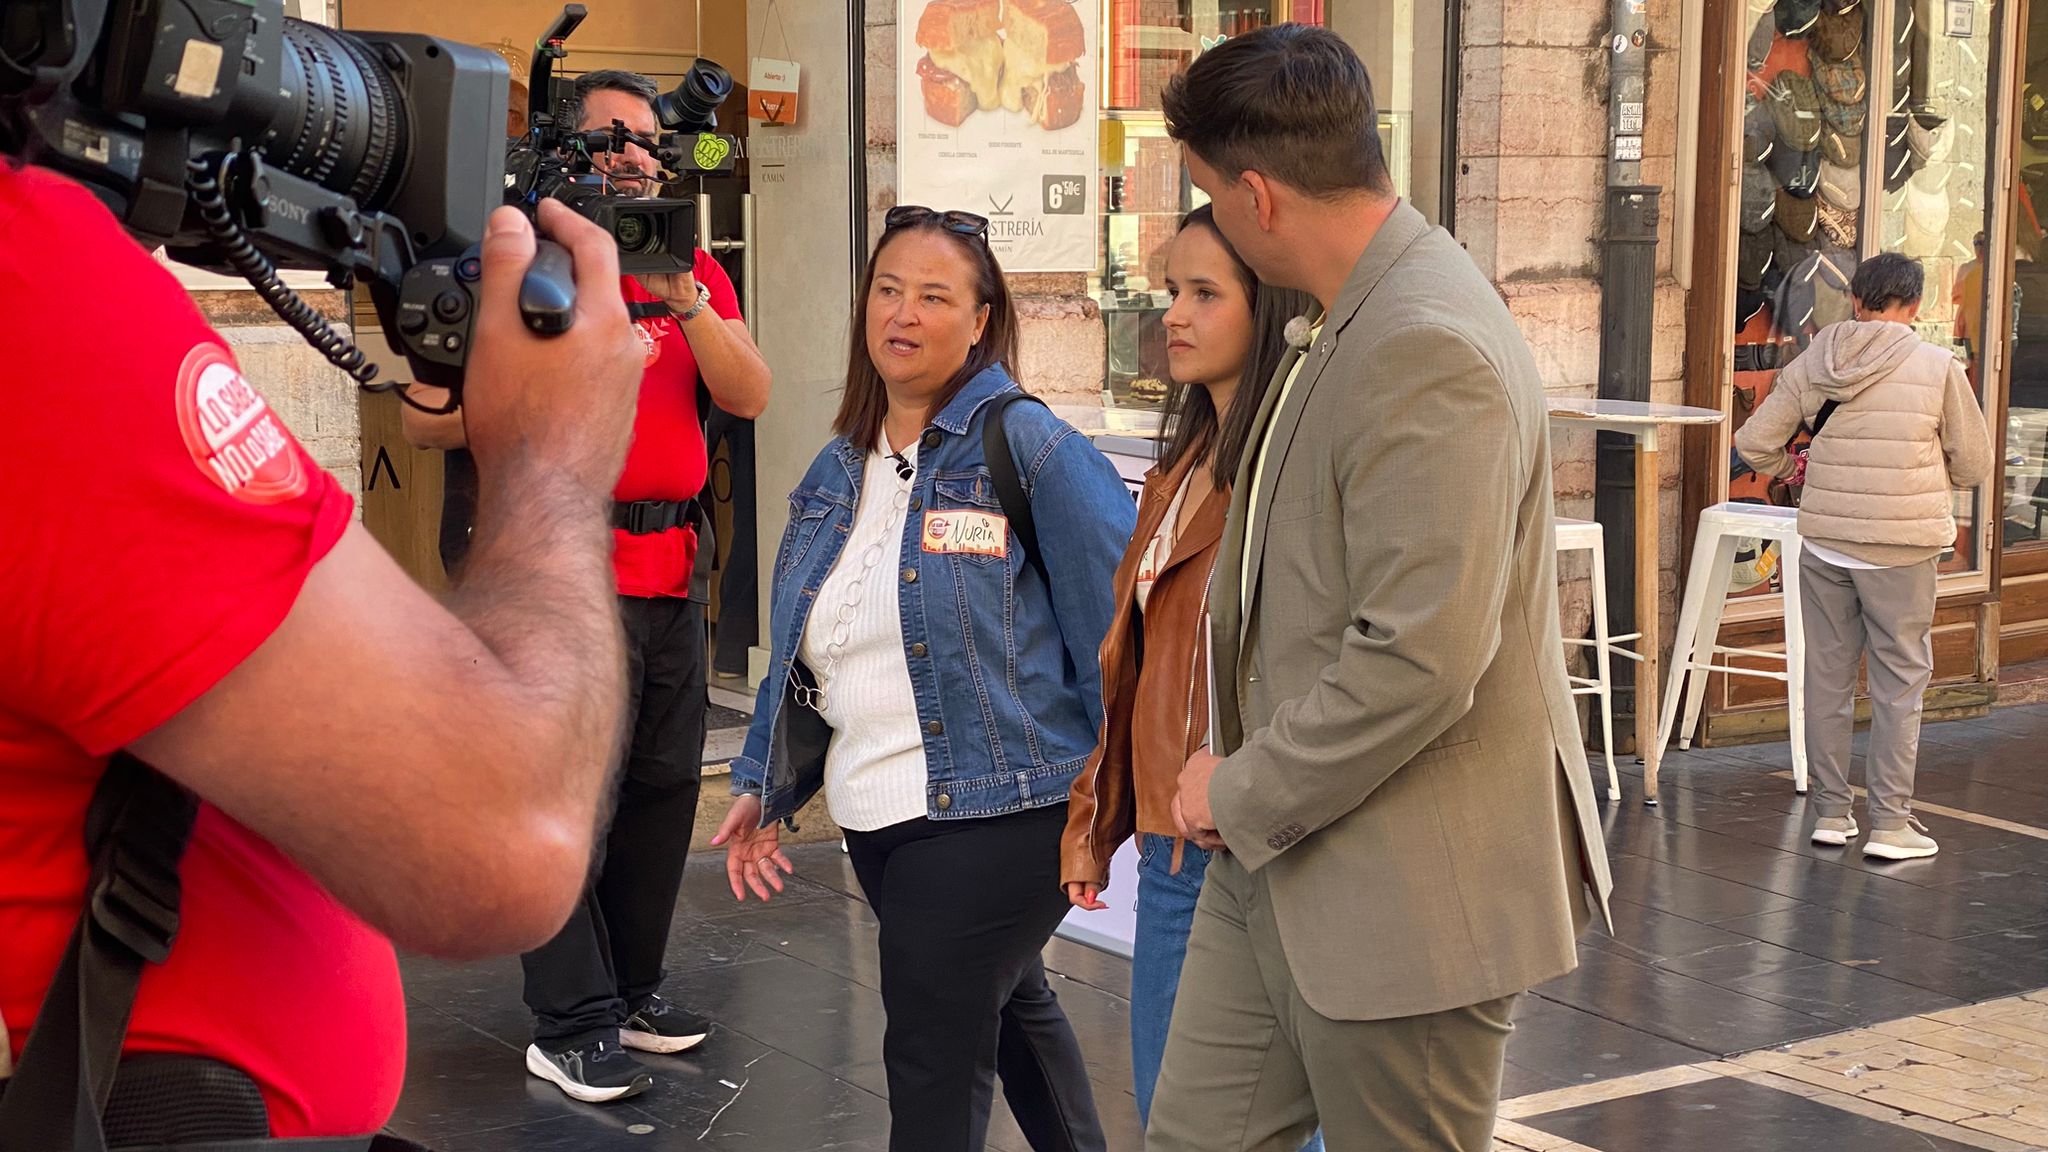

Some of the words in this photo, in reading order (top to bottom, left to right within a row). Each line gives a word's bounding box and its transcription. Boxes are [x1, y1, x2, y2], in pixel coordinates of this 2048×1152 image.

[269, 194, 311, 225] SONY
[199, 398, 230, 434] LO
[208, 444, 254, 494] NO
